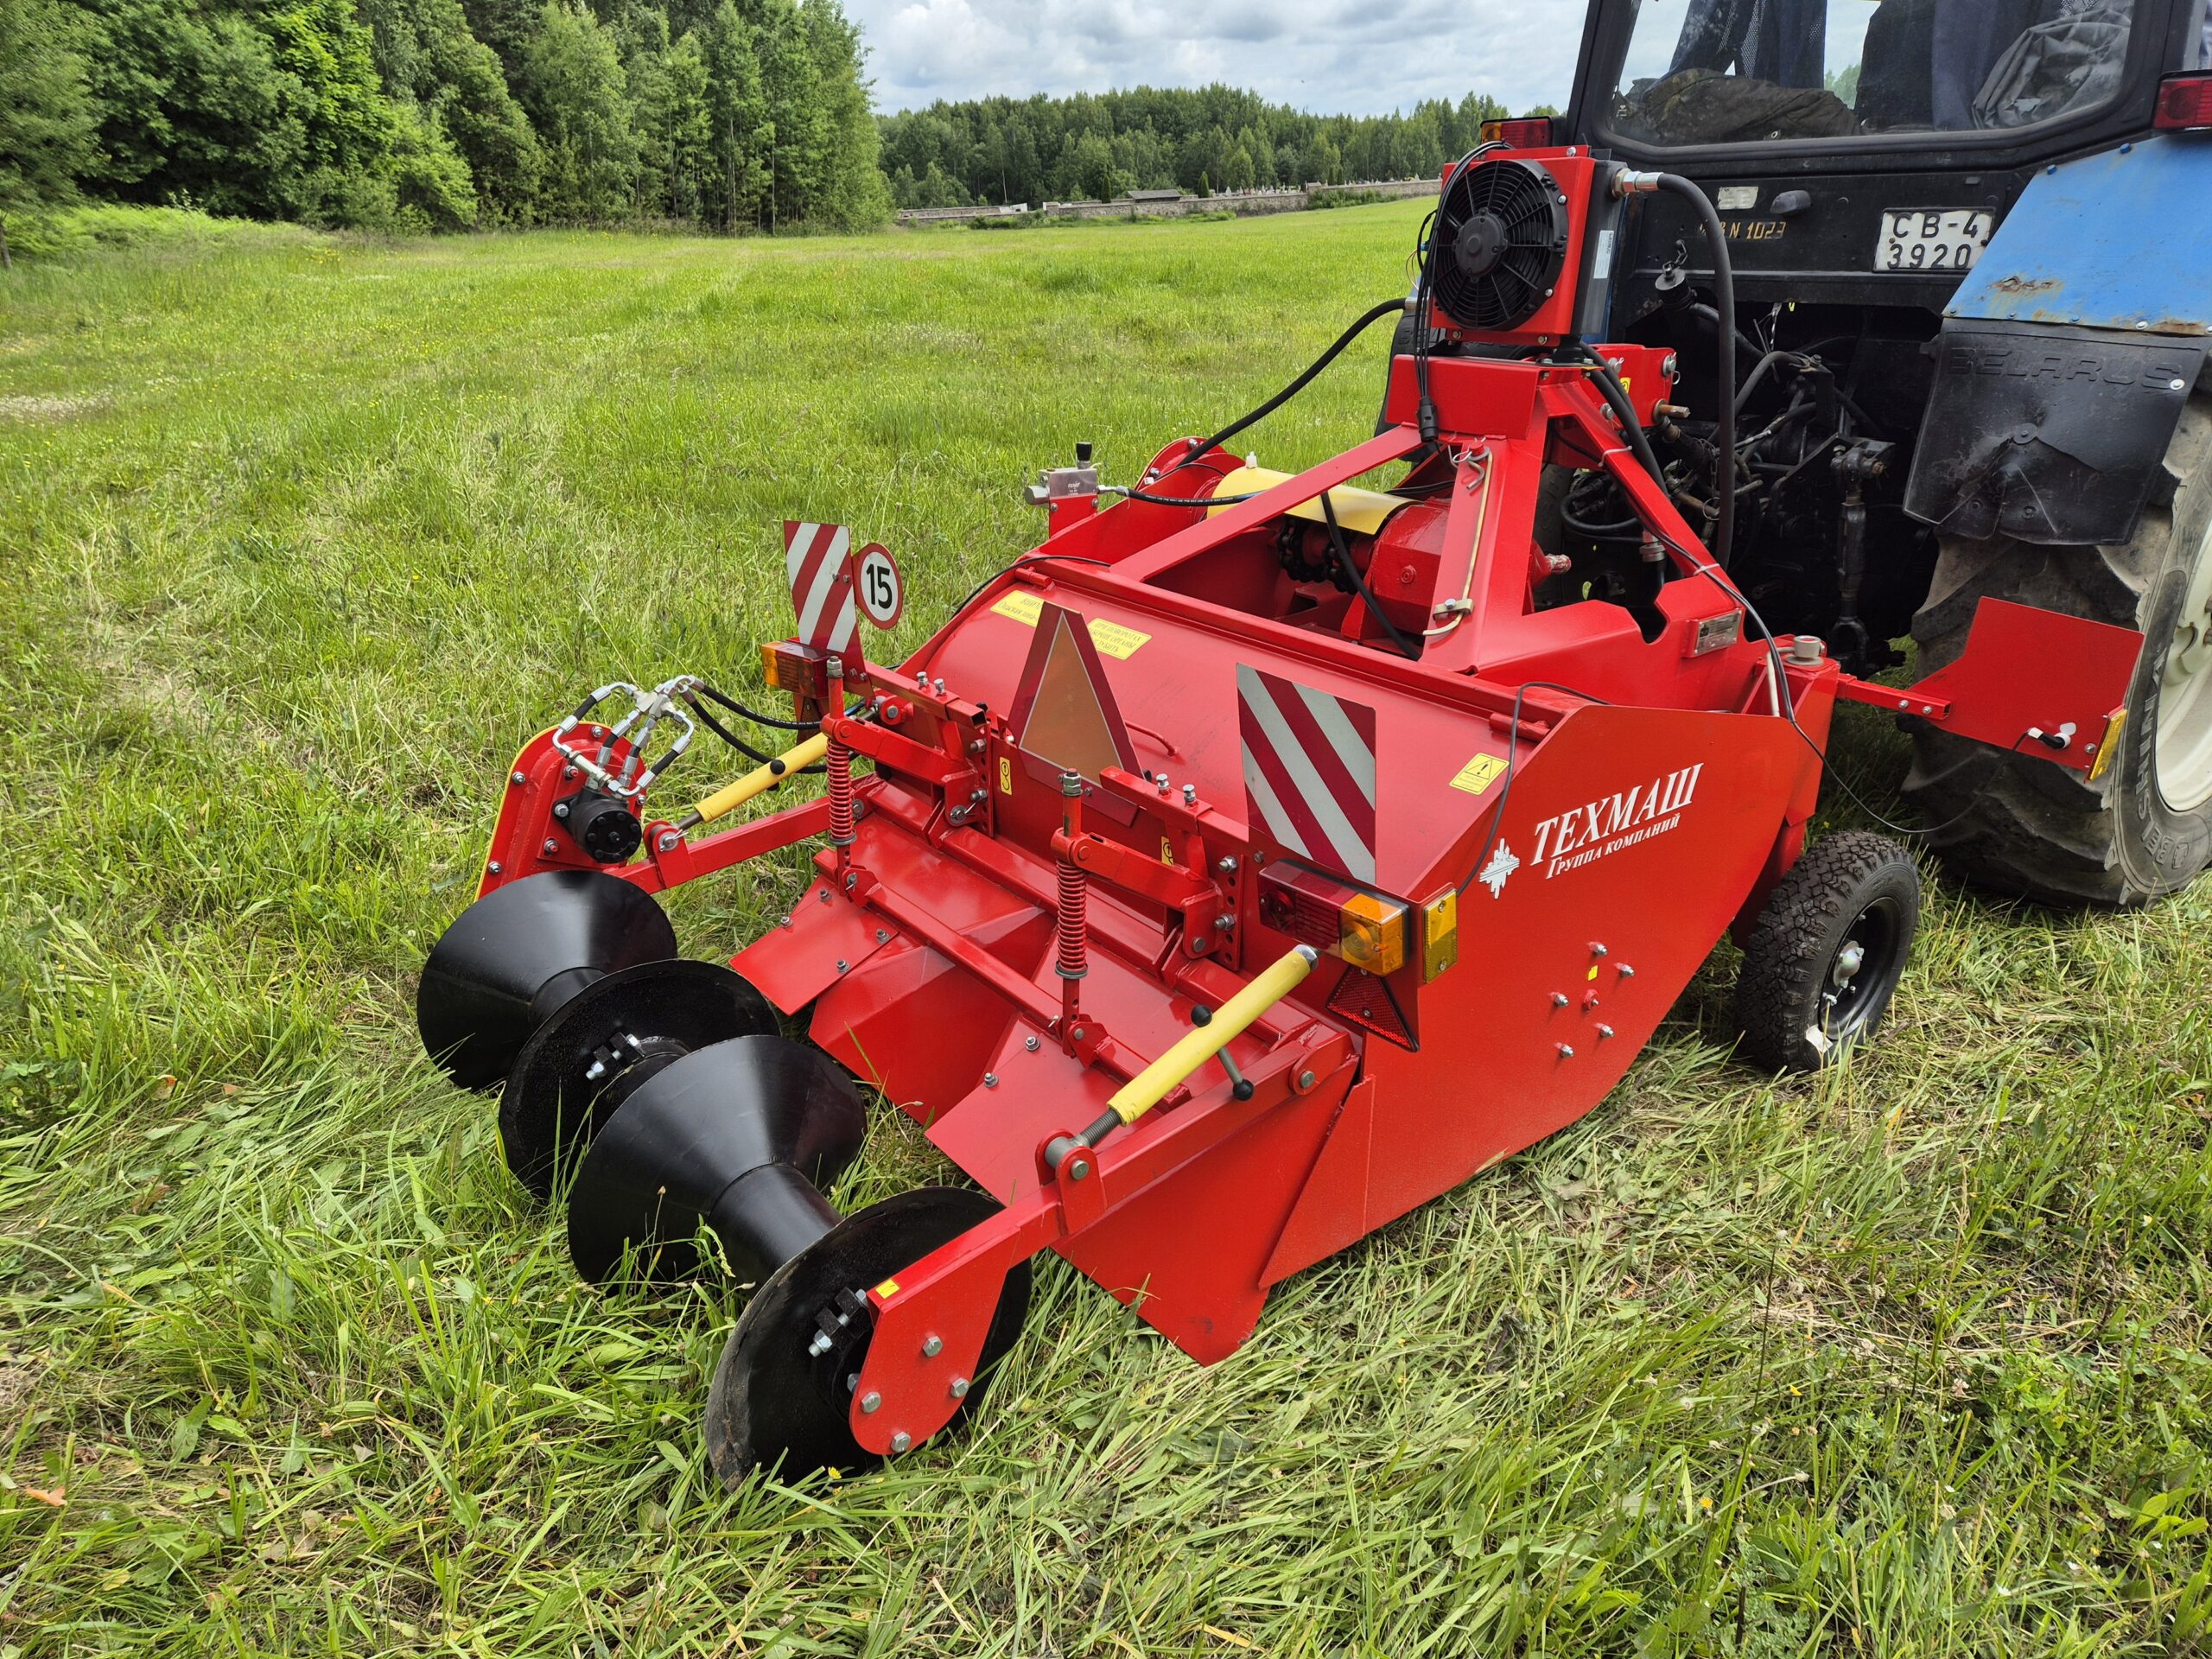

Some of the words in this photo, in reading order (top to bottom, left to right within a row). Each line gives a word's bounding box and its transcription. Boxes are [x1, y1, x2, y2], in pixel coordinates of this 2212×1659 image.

[1745, 221, 1787, 239] 1023
[1886, 244, 1972, 270] 3920
[1948, 347, 2184, 390] BELARUS
[866, 563, 893, 609] 15
[1530, 763, 1704, 866] ТЕХМАШ
